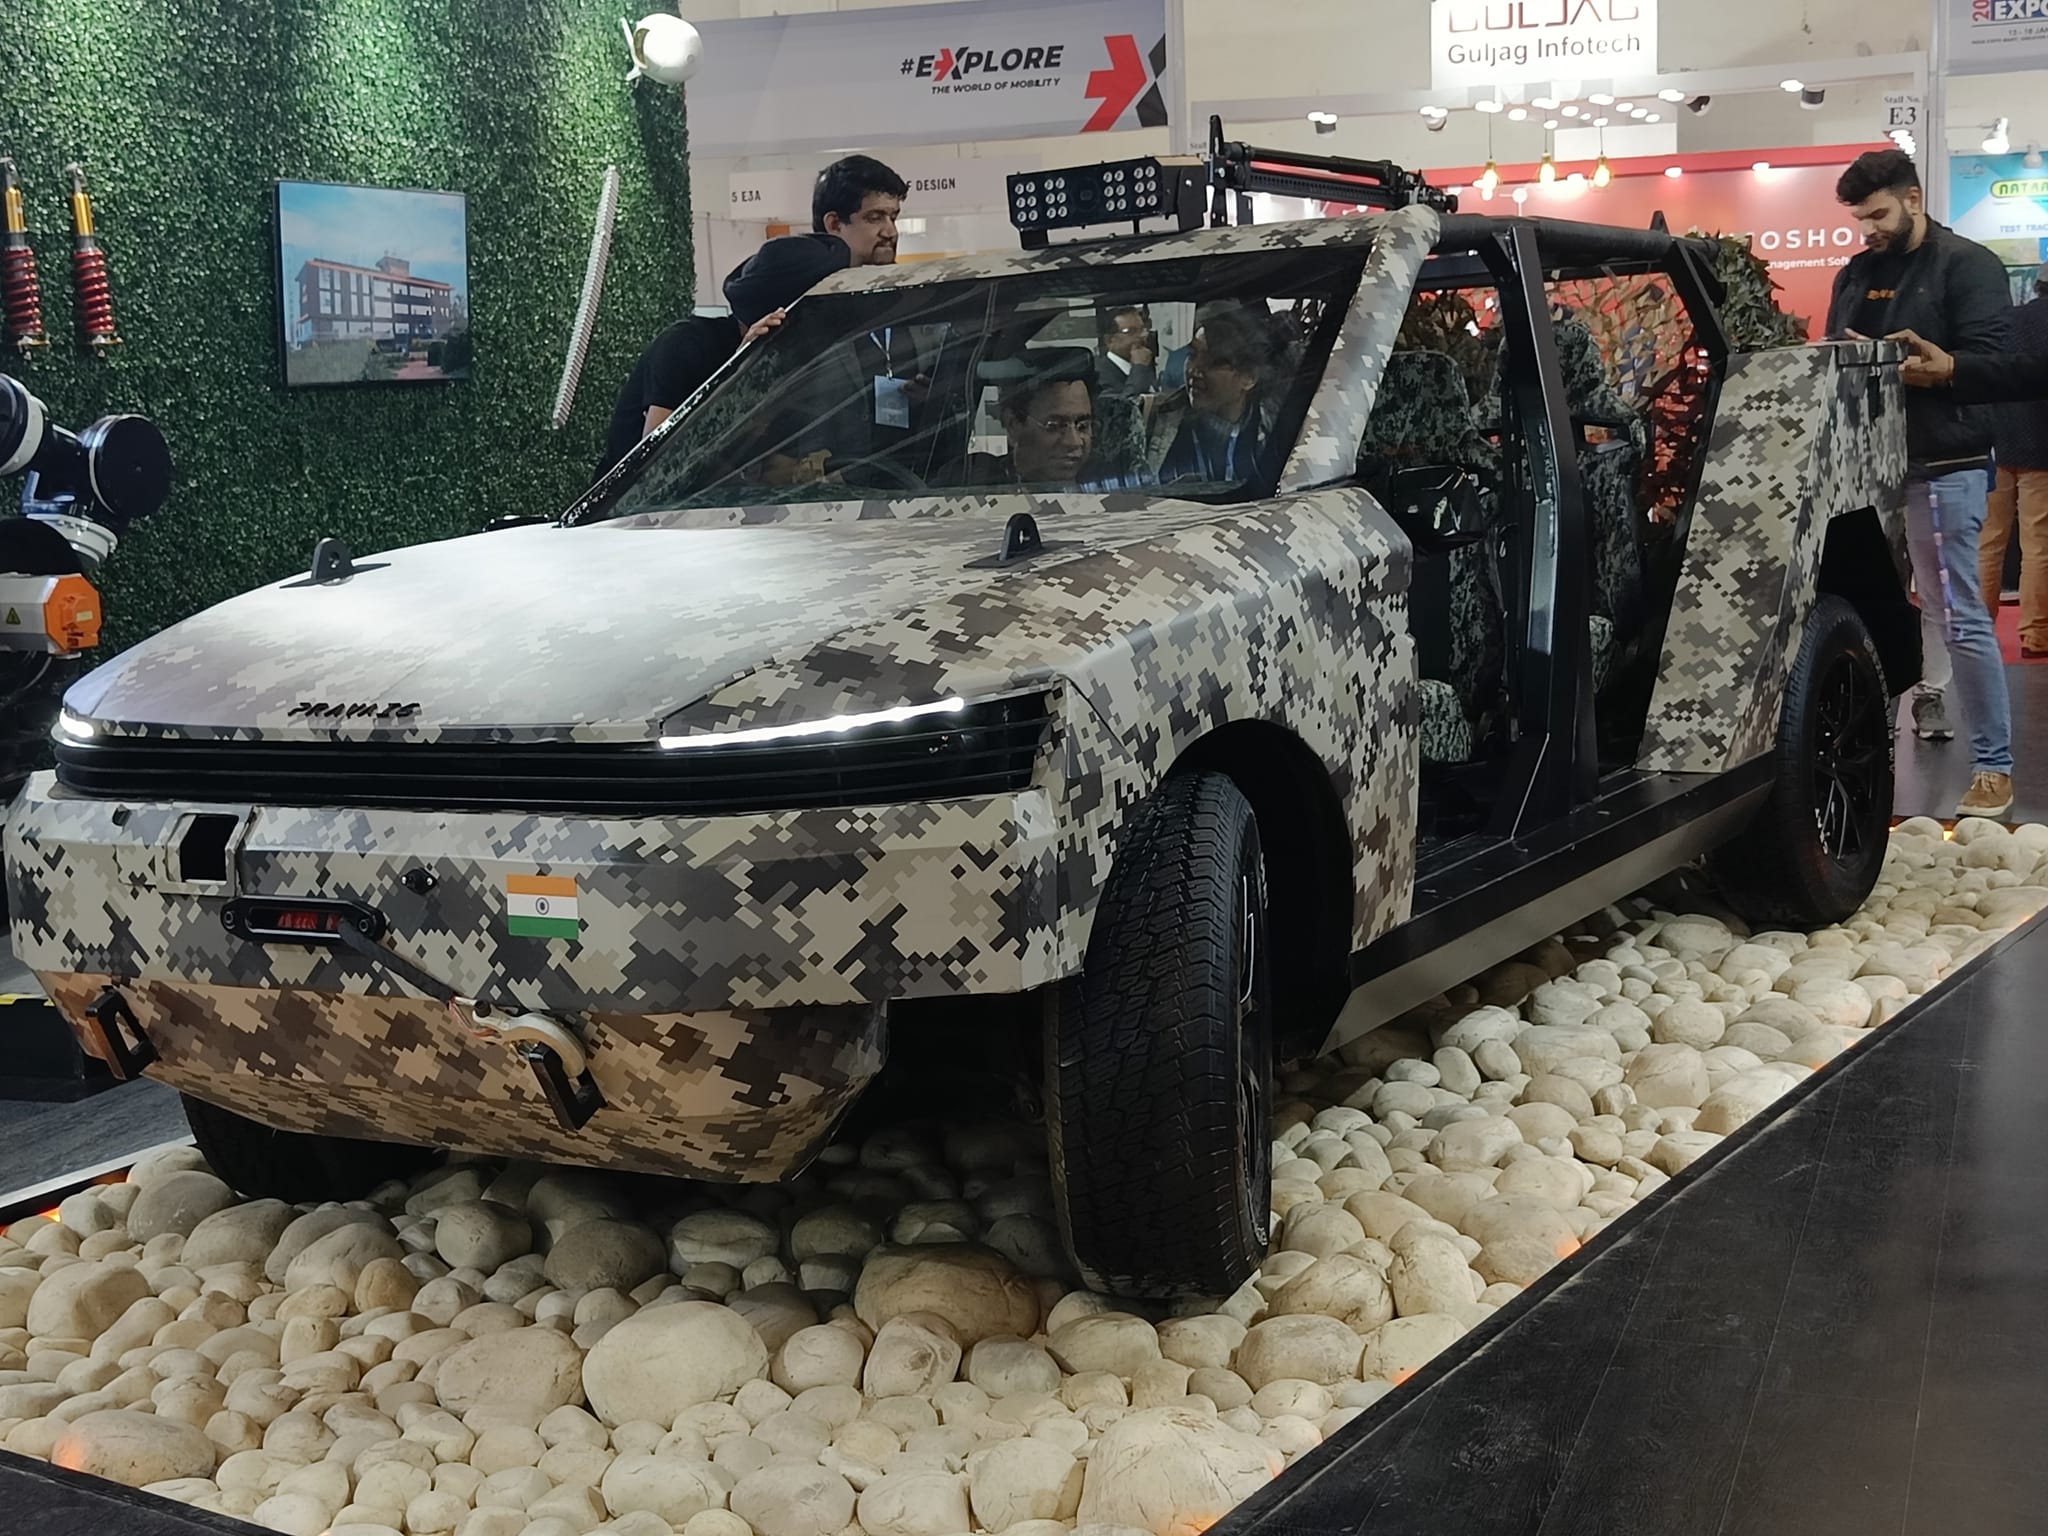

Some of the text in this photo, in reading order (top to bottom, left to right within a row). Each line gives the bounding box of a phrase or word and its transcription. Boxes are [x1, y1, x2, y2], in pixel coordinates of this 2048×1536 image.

[1448, 33, 1641, 67] Guljag Infotech
[900, 45, 1064, 82] #EXPLORE
[931, 77, 1061, 95] THE WORLD OF MOBILITY
[1889, 106, 1917, 126] E3
[915, 178, 956, 192] DESIGN
[2000, 224, 2021, 233] TEST
[1765, 258, 1825, 271] nagement
